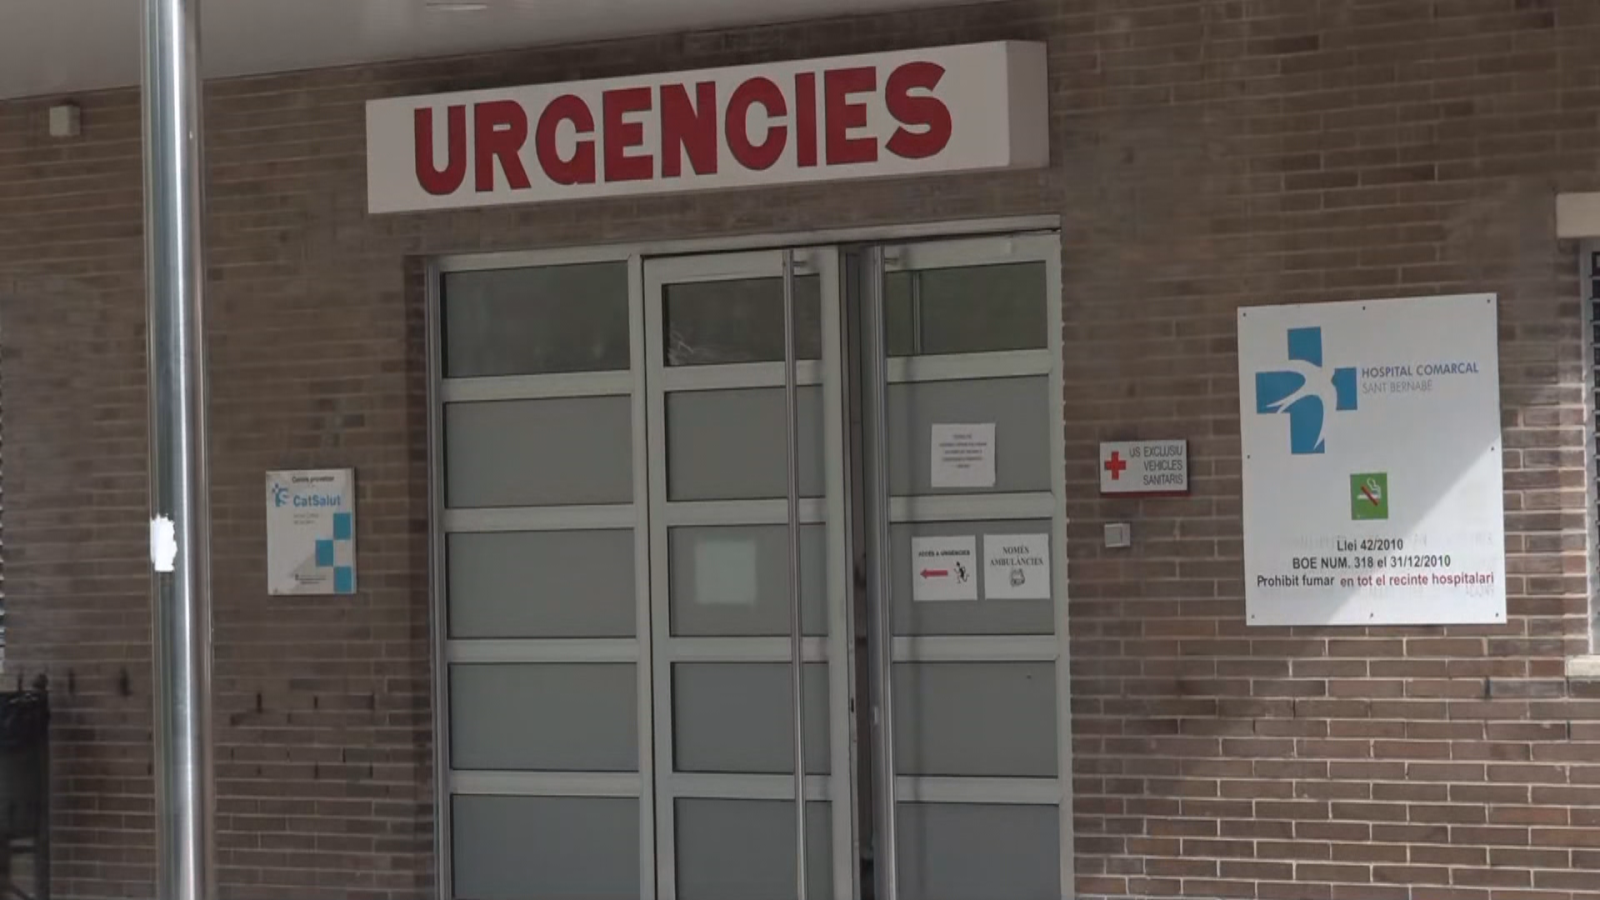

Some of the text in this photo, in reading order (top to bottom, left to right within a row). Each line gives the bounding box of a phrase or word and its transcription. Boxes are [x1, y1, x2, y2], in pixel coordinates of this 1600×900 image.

[414, 61, 953, 196] URGENCIES
[1361, 361, 1479, 380] HOSPITAL COMARCAL
[1362, 382, 1387, 395] SANT
[1129, 445, 1183, 459] US EXCLUSIU
[1143, 460, 1183, 472] VEHICLES
[1143, 474, 1183, 486] SANITARIS
[293, 493, 341, 507] CatSalut
[1336, 538, 1358, 551] Llei
[1360, 537, 1404, 551] 42/2010
[1292, 554, 1451, 569] BOE NUM. 318 el 31/12/2010
[1257, 572, 1494, 587] Prohibit fumar en tot el recinte hospitalari
